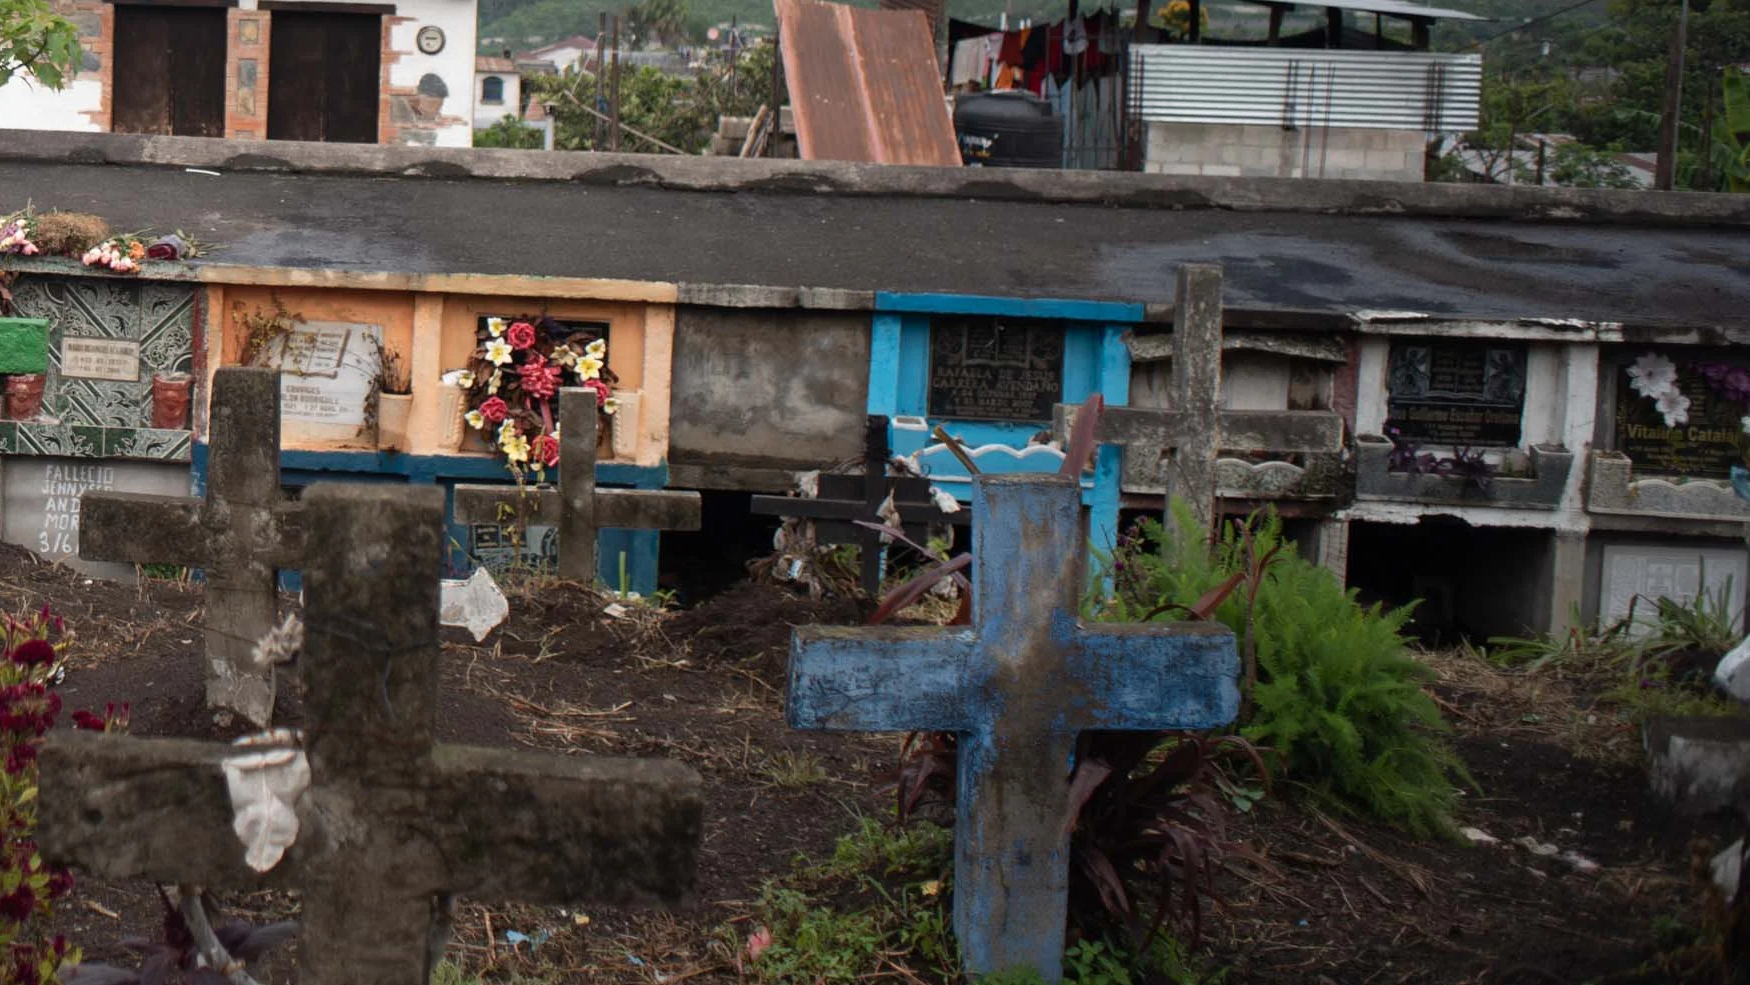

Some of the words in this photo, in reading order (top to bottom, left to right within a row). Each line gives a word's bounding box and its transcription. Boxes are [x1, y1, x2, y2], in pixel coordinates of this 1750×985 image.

[45, 464, 114, 485] FALLECIO
[46, 497, 81, 513] AND
[45, 513, 80, 530] MOR
